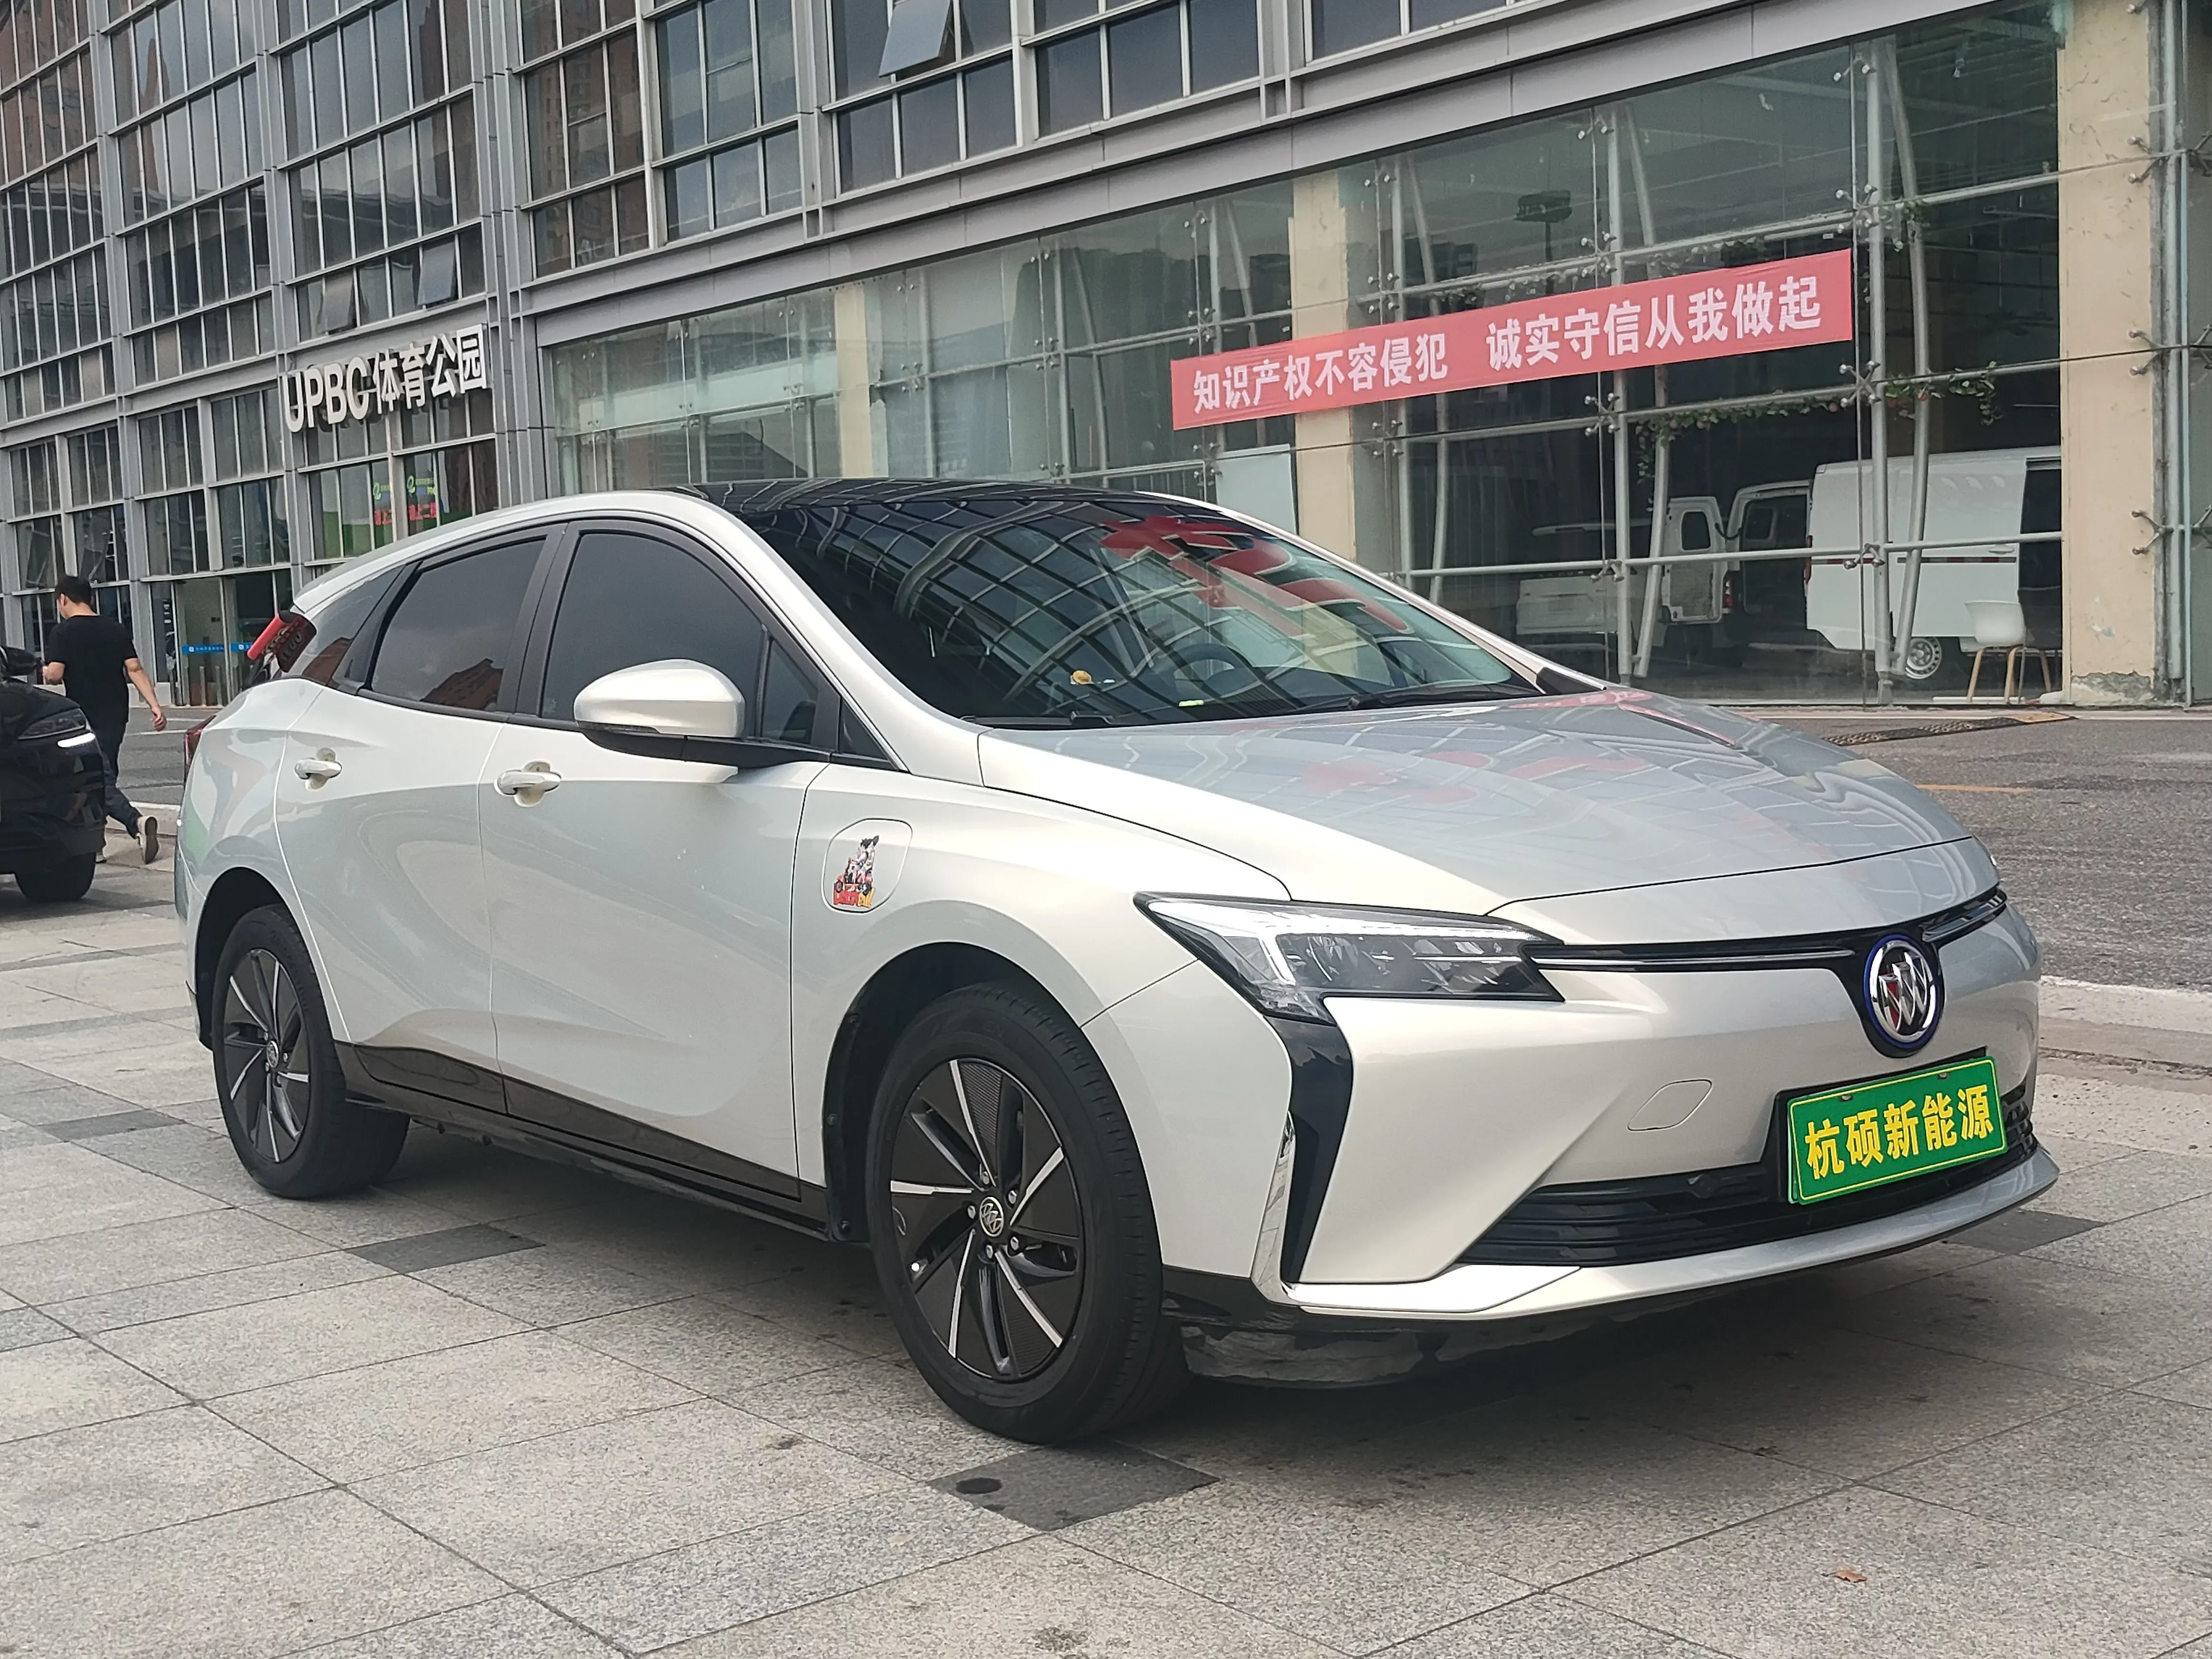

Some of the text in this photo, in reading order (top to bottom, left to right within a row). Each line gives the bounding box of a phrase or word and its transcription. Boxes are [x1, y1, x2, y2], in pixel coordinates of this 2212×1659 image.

[1193, 276, 1821, 414] 知识产权不容侵犯 诚实守信从我做起
[1805, 1084, 1993, 1179] 杭硕新能源
